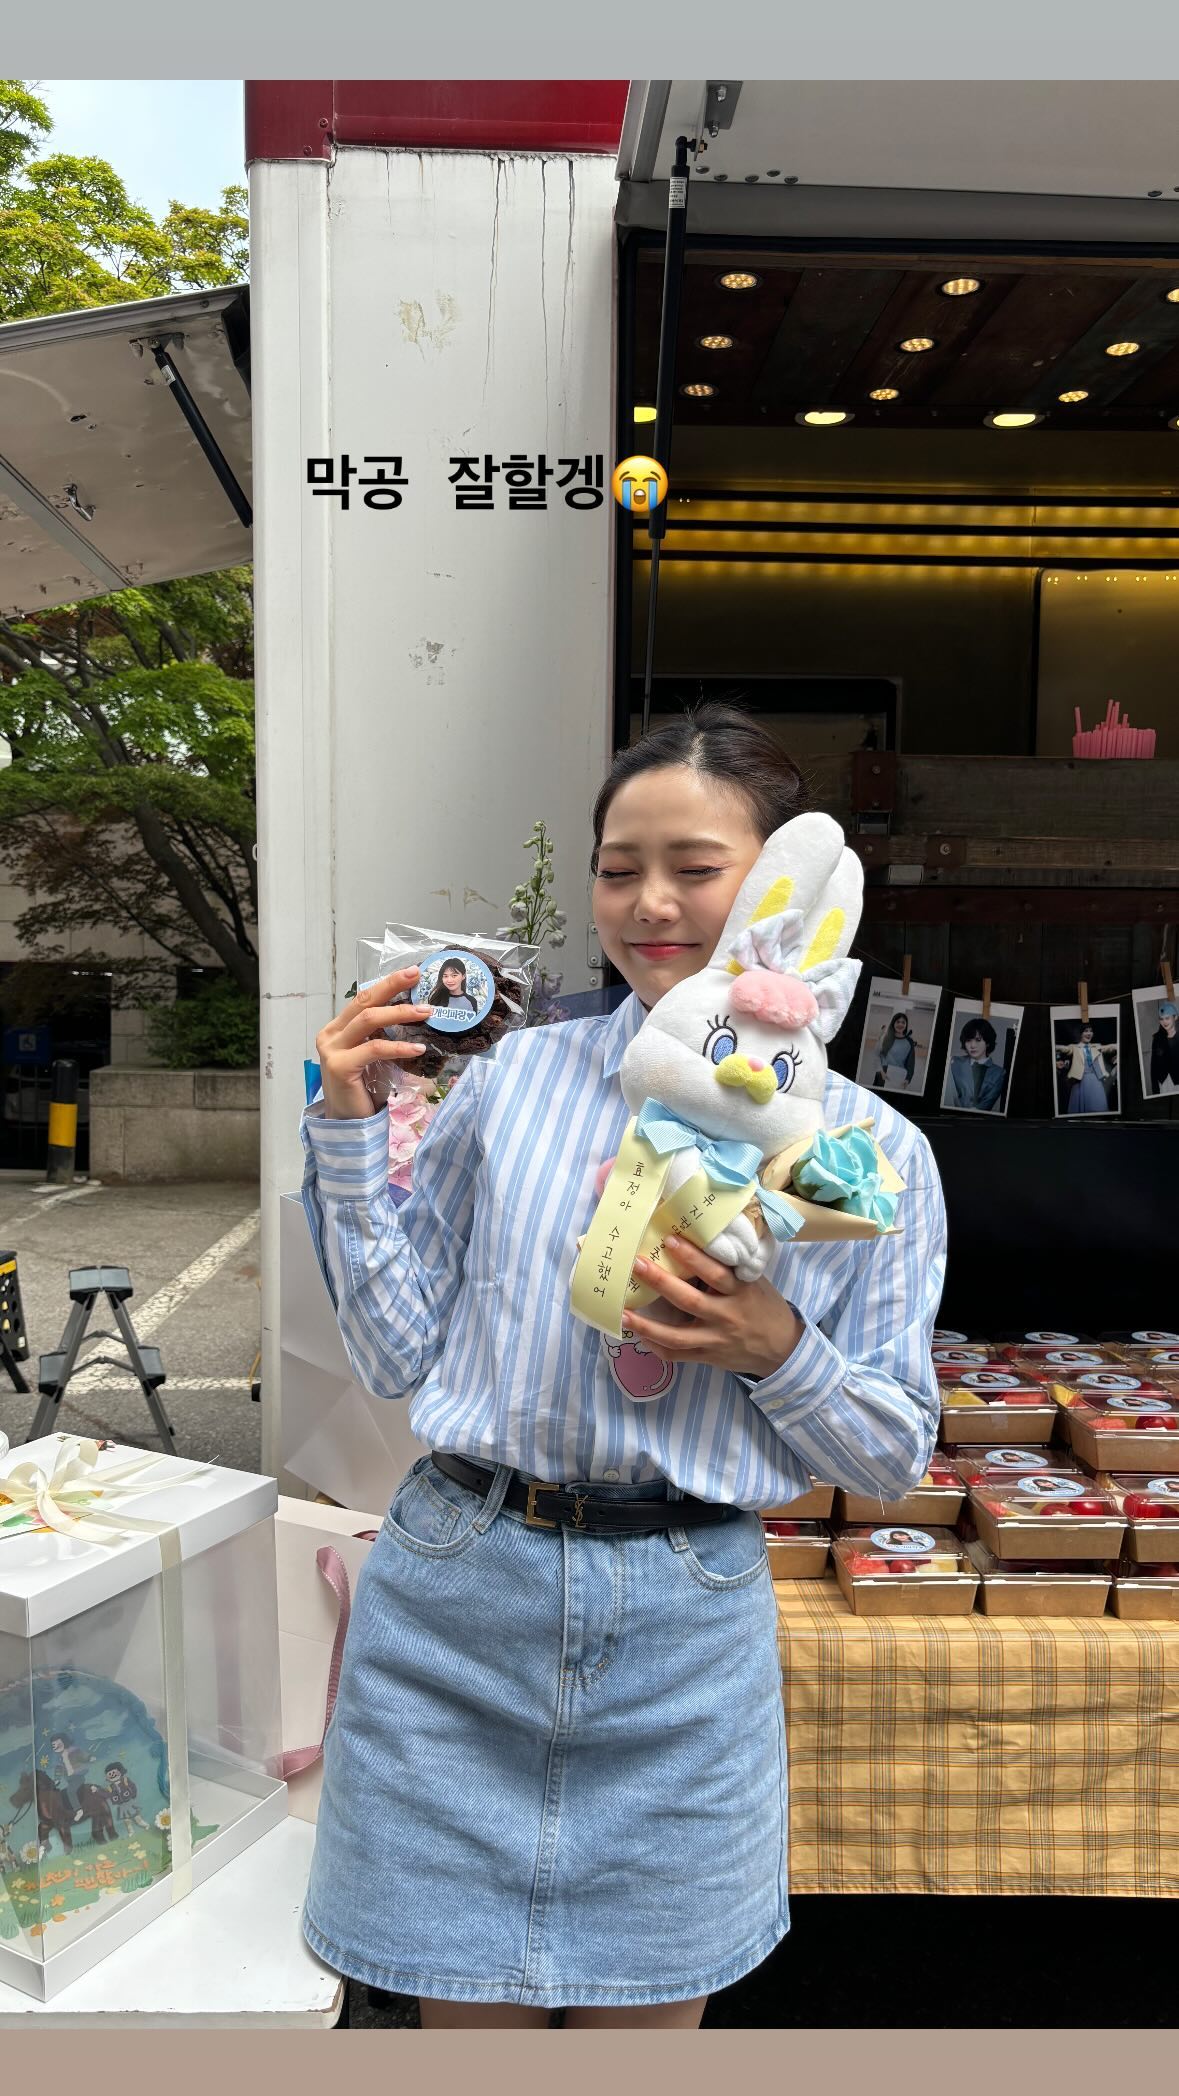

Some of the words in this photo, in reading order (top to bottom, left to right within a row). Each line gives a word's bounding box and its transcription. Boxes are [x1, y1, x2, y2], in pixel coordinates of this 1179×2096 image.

[431, 1008, 467, 1021] 개의파랑
[619, 1161, 645, 1211] 효정아
[593, 1225, 620, 1297] 수고했어
